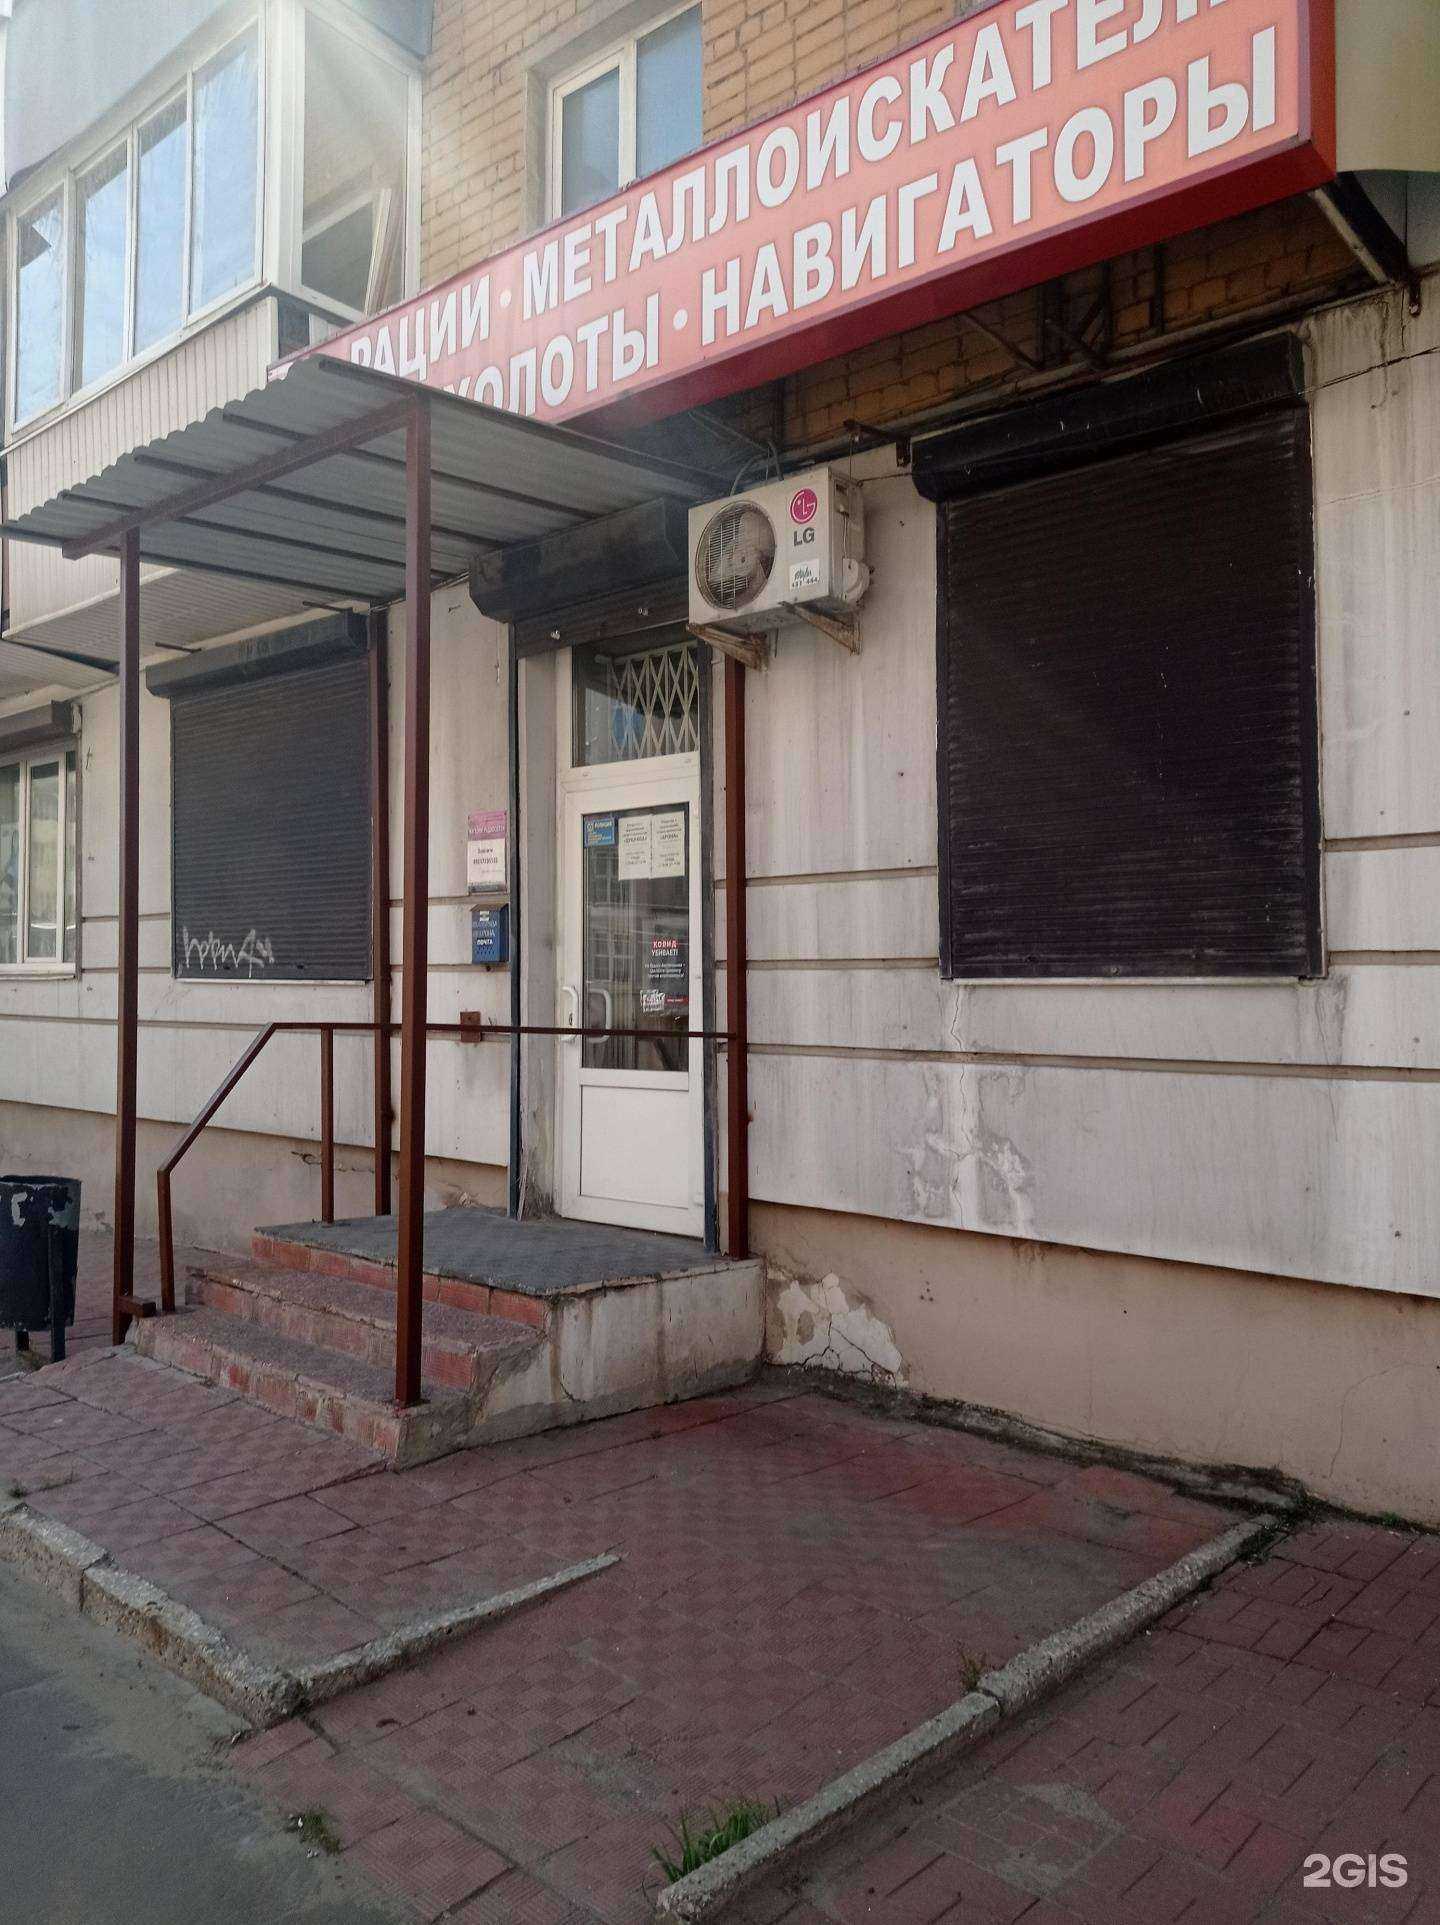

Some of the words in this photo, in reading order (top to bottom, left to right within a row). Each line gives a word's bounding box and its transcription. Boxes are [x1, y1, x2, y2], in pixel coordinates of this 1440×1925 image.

[350, 274, 491, 381] РАЦИИ
[522, 0, 1226, 321] МЕТАЛЛОИСКАТЕ
[442, 292, 661, 418] ОЛОТЫ
[701, 25, 1276, 346] НАВИГАТОРЫ
[793, 527, 816, 547] LG
[652, 940, 677, 949] КОВИД
